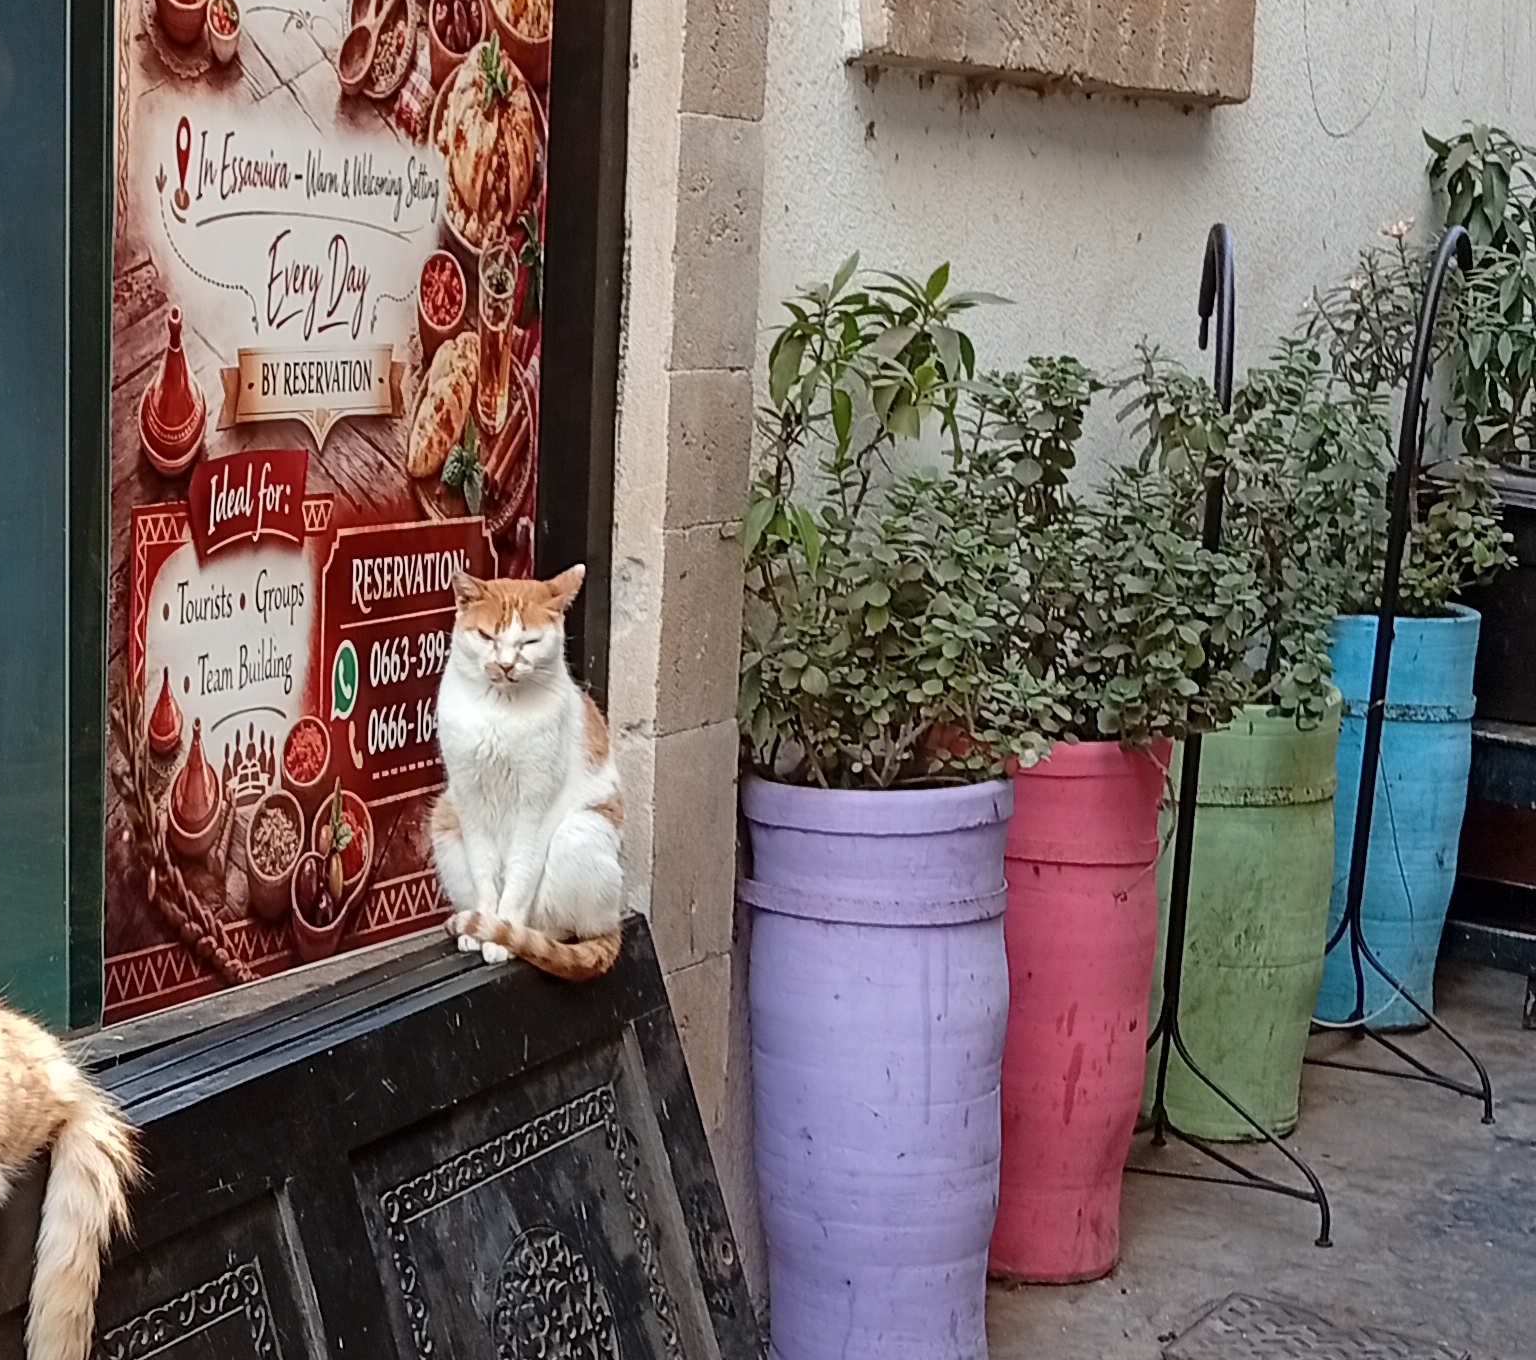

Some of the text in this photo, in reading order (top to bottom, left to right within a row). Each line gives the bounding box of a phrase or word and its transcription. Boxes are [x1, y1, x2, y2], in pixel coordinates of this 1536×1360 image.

[195, 130, 217, 201] In
[220, 131, 292, 200] Essaouira
[306, 148, 340, 200] Warm
[341, 158, 351, 200] &
[353, 152, 403, 223] Welcoming
[406, 155, 440, 224] Setting
[267, 229, 372, 342] Every Day
[261, 359, 373, 397] BY RESERVATION
[208, 463, 291, 541] Ideal for:
[177, 569, 305, 625] Tourists Groups
[197, 637, 293, 696] Team Building
